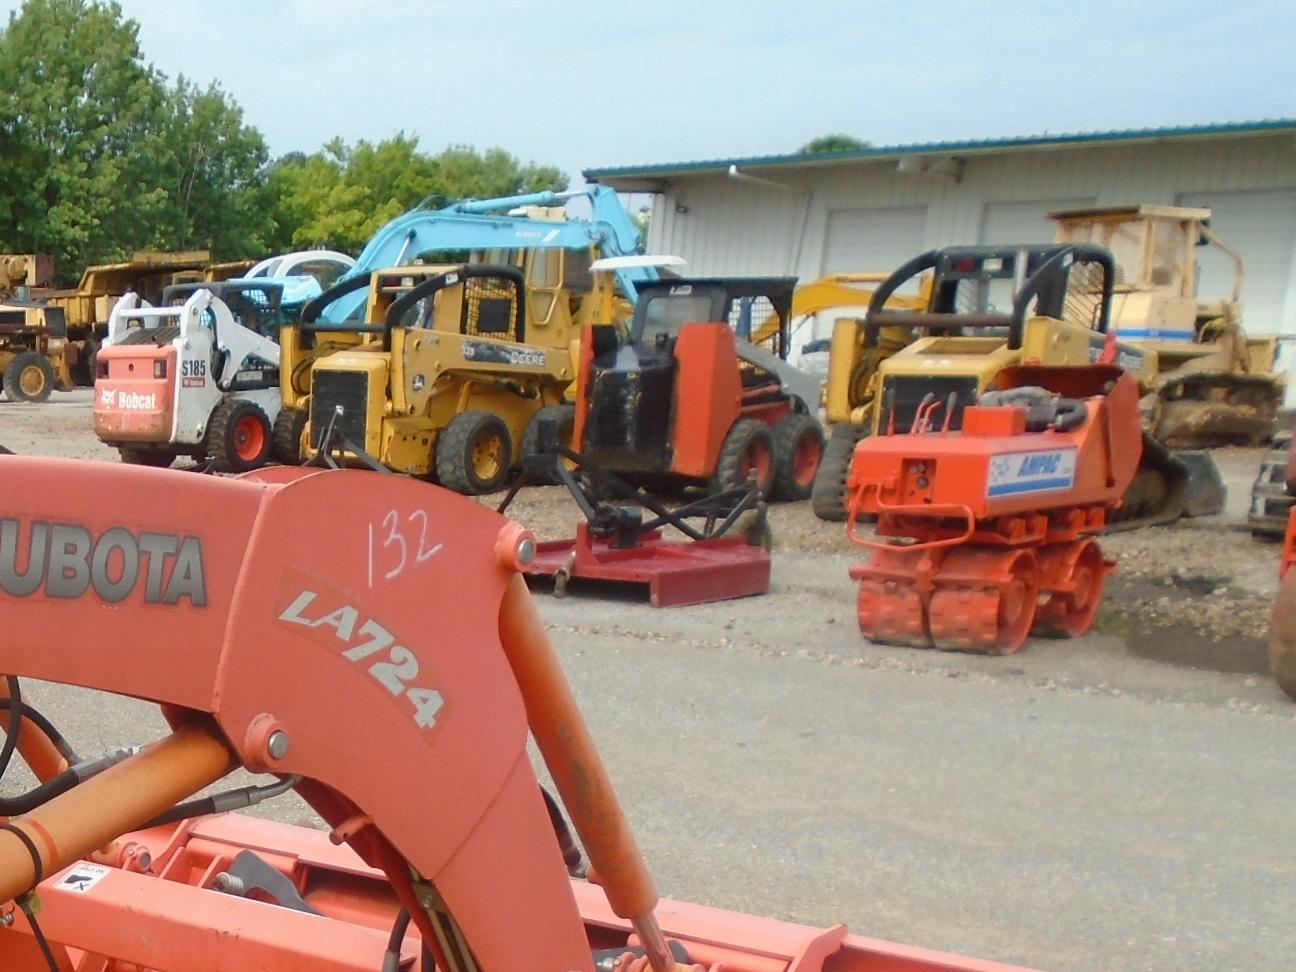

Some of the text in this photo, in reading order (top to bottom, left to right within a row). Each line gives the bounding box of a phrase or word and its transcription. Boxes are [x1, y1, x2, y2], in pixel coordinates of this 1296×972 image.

[511, 350, 545, 366] DEERE
[182, 360, 206, 377] S185
[119, 391, 155, 410] Bobcat
[368, 509, 443, 588] 132
[279, 590, 444, 728] LA724
